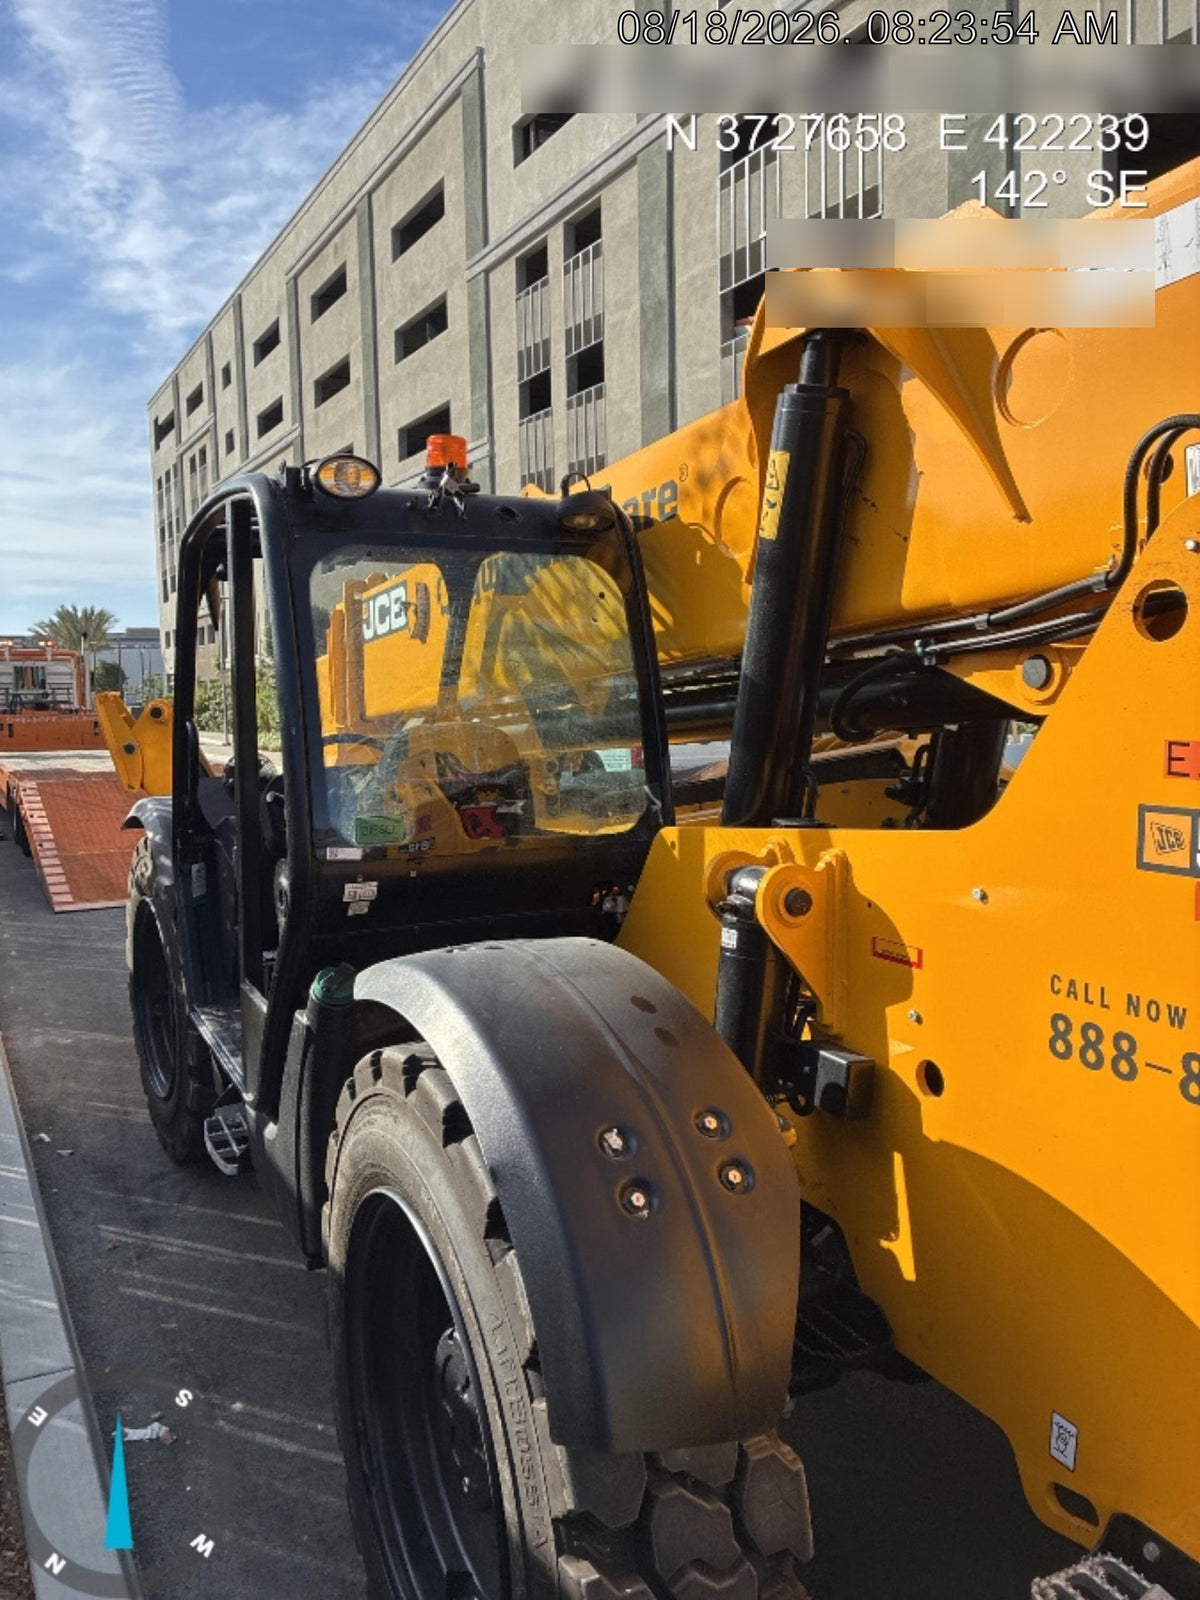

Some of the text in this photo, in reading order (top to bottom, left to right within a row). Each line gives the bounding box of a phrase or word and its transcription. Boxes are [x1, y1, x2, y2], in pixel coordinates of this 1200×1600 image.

[362, 585, 408, 641] JCB
[1167, 740, 1200, 778] E
[1155, 824, 1186, 852] JCB
[1050, 973, 1187, 1030] CALL NOW
